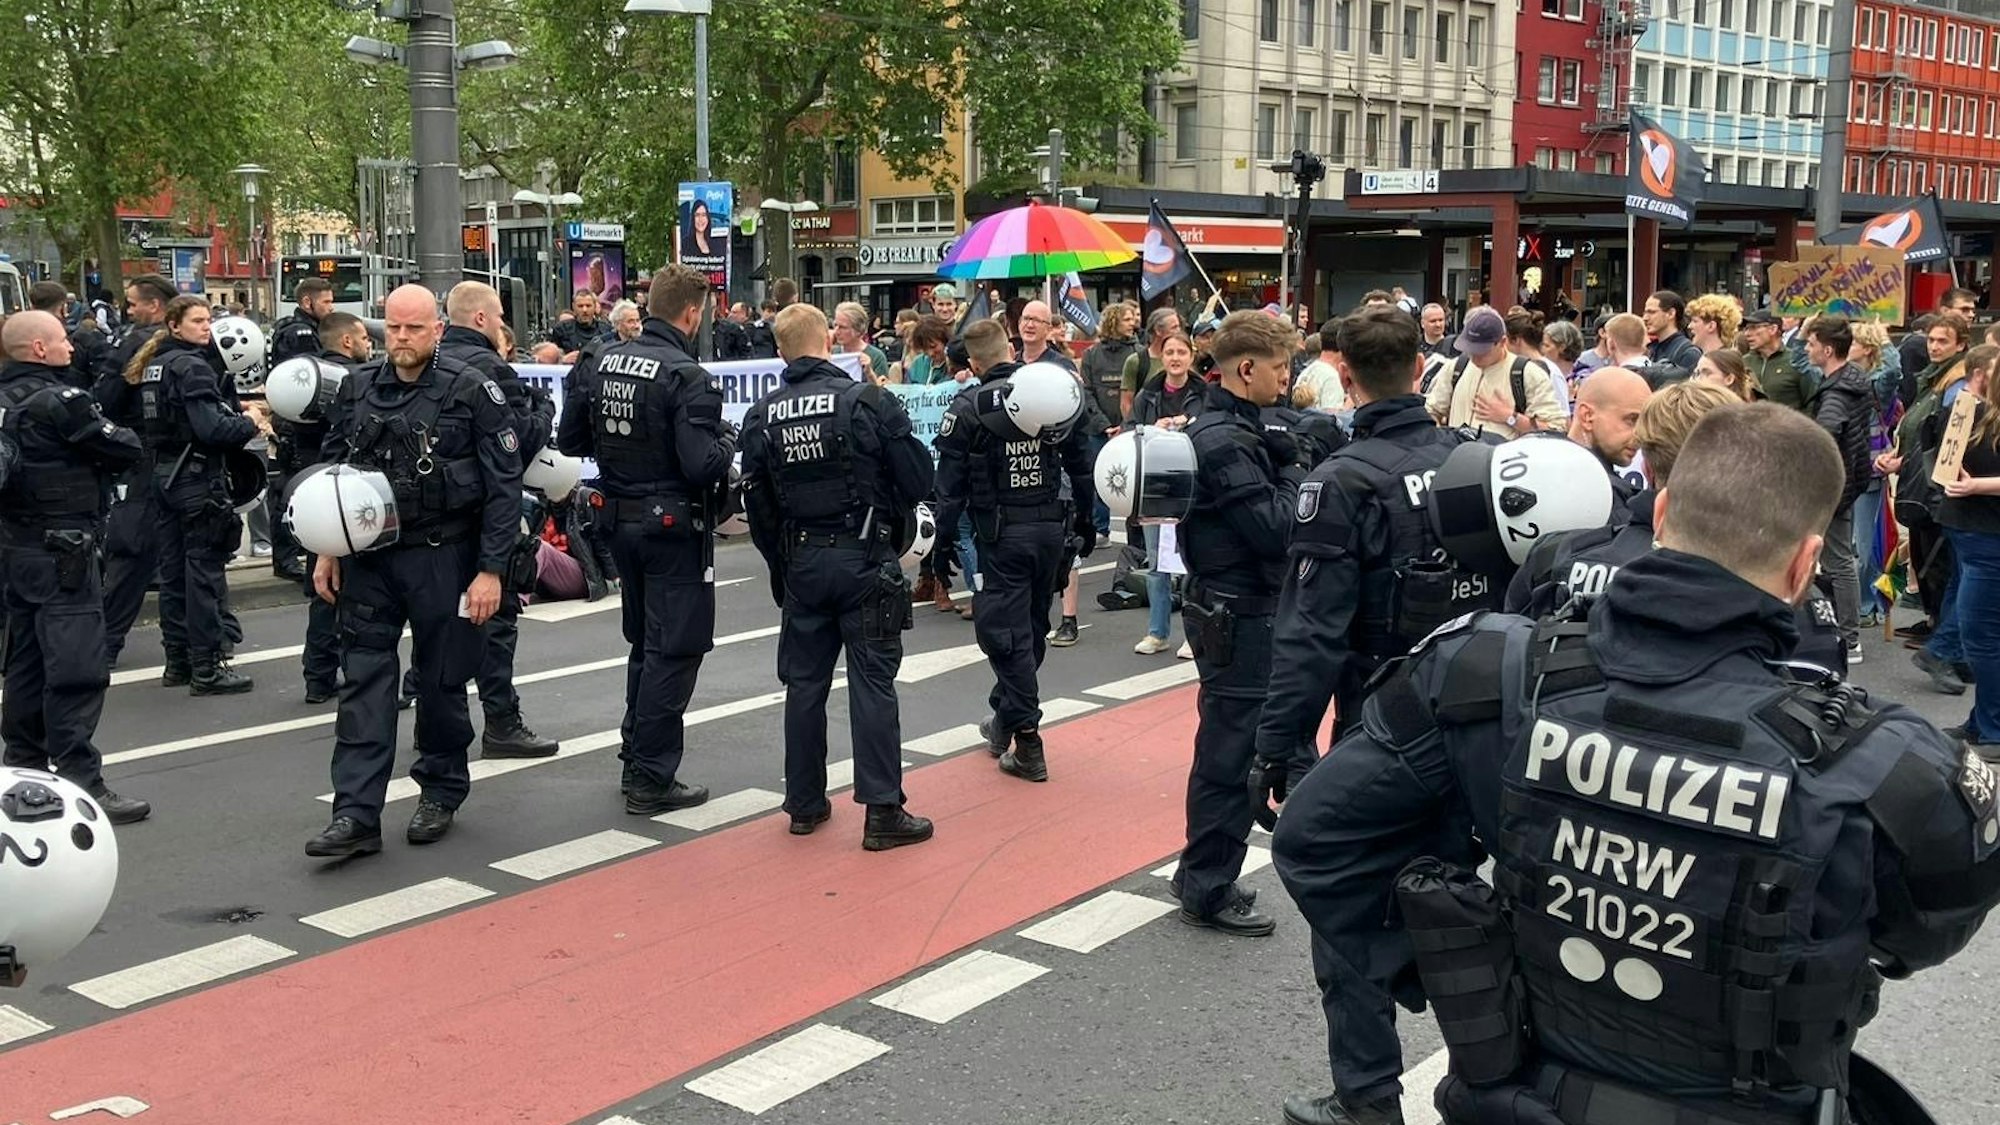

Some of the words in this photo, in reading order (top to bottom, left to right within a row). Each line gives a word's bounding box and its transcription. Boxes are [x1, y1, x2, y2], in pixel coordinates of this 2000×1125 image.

[1426, 178, 1436, 189] 4
[570, 224, 582, 238] U
[584, 226, 622, 238] Heumarkt
[811, 216, 830, 229] THAI
[1176, 227, 1204, 243] arkt
[873, 246, 888, 264] ICE
[889, 246, 922, 263] CREAM
[598, 353, 661, 380] POLIZEI
[602, 380, 636, 400] NRW
[602, 400, 634, 420] 21011
[768, 393, 834, 424] POLIZEI
[781, 424, 822, 445] NRW
[784, 442, 824, 464] 21011
[1006, 439, 1041, 456] NRW
[1009, 456, 1040, 472] 2102
[1500, 452, 1529, 482] 10
[1010, 472, 1042, 488] BeSi
[1507, 522, 1540, 542] 2
[1524, 718, 1790, 839] POLIZEI
[1551, 817, 1696, 899] NRW
[1546, 875, 1695, 960] 21022
